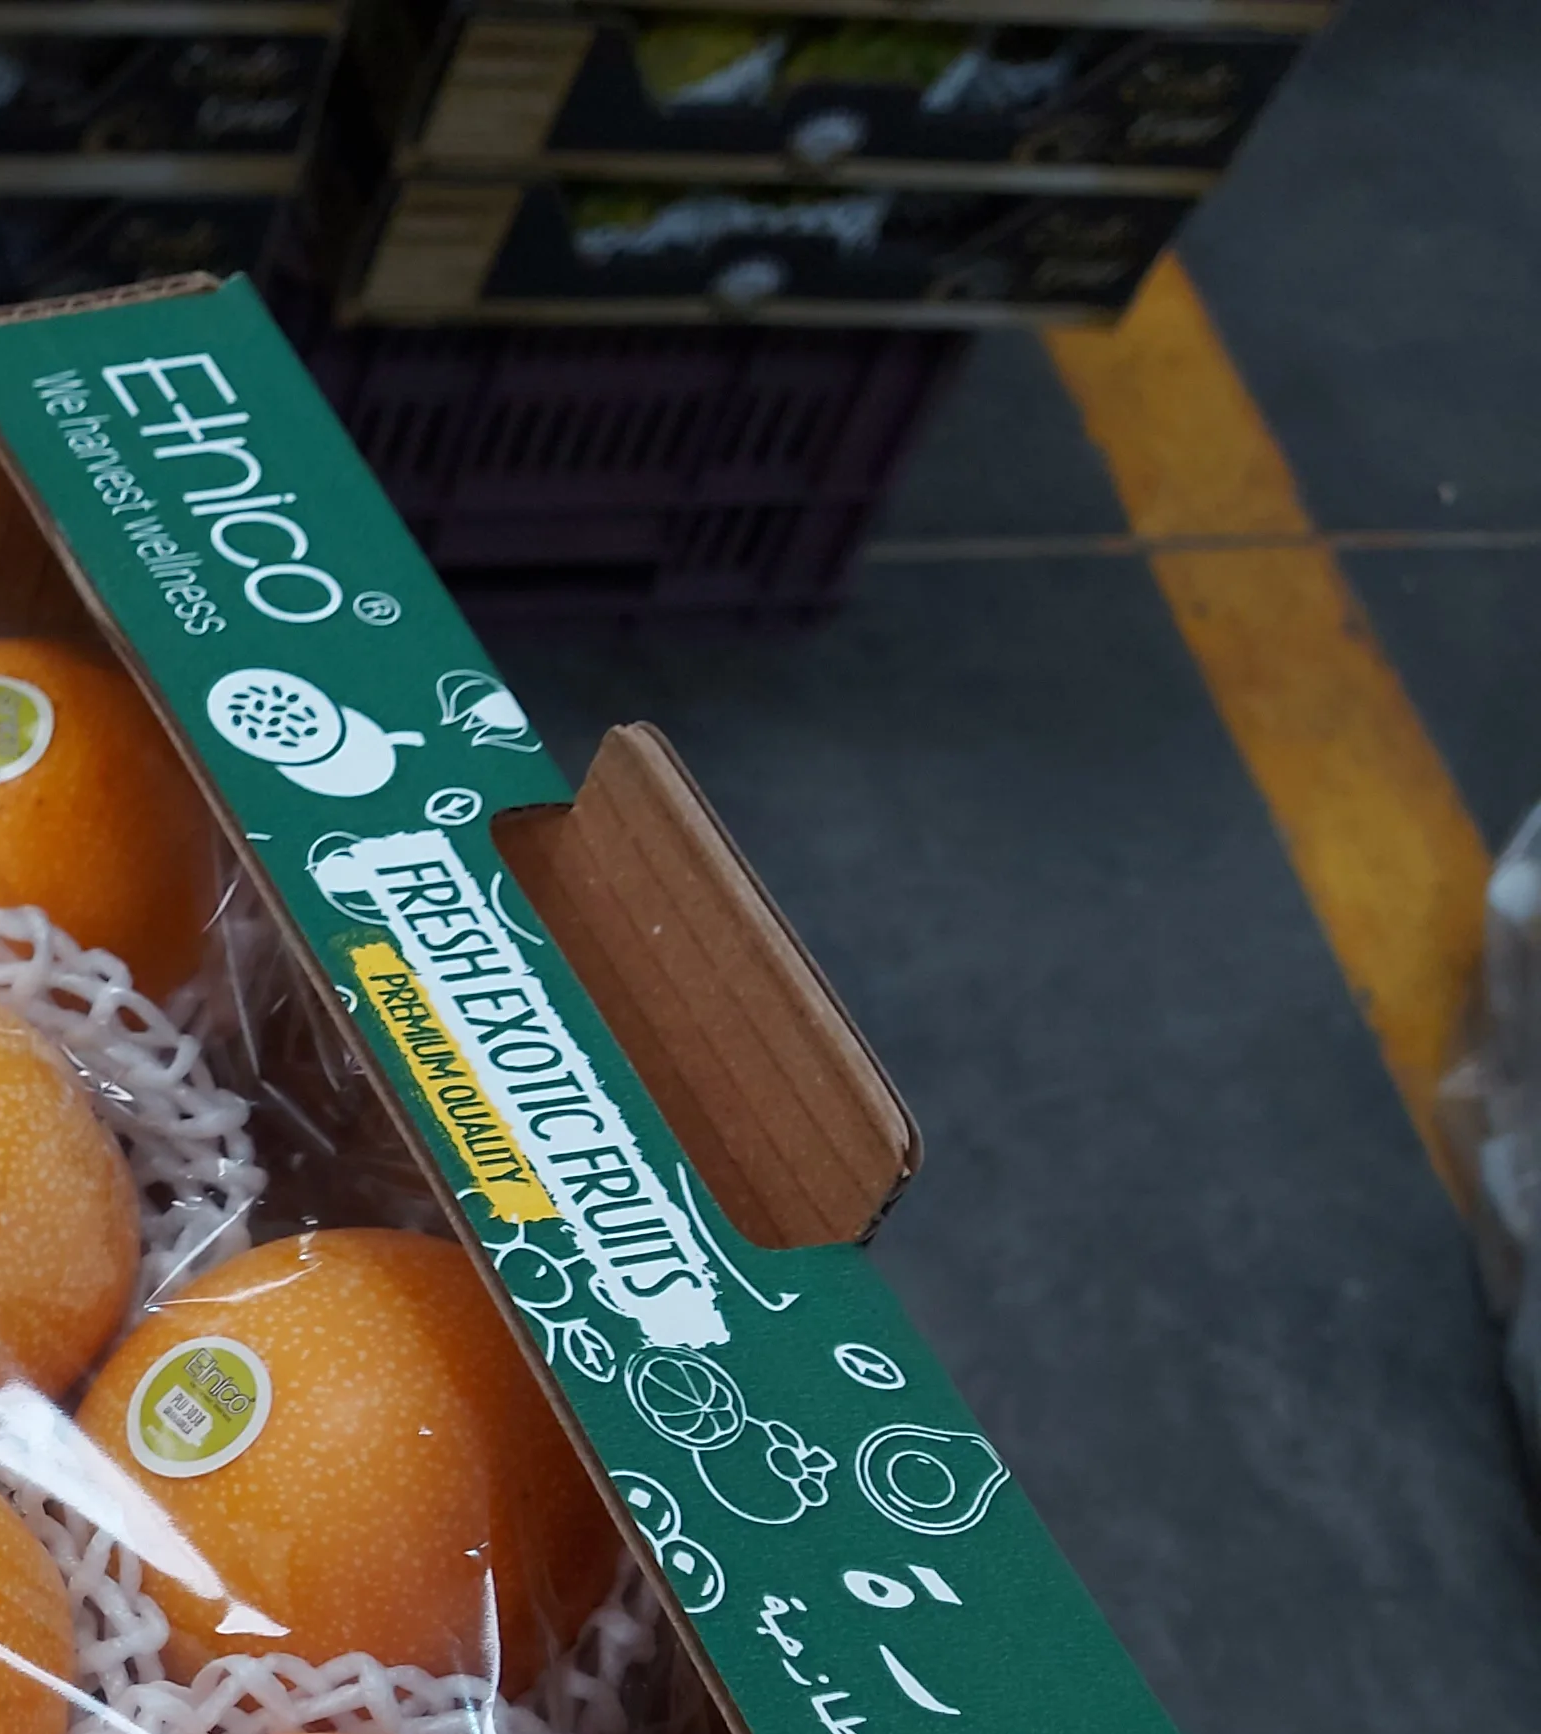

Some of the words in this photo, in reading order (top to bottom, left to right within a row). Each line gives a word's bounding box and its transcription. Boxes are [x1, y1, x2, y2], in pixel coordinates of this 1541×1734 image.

[32, 368, 91, 417] We
[59, 414, 158, 517] harvest
[124, 512, 227, 637] wellness
[369, 972, 465, 1081] PREMIUM
[438, 1084, 533, 1189] QUALITY
[375, 860, 512, 983] FRESH
[458, 987, 605, 1142] EXOTIC
[548, 1145, 703, 1299] FRUITS
